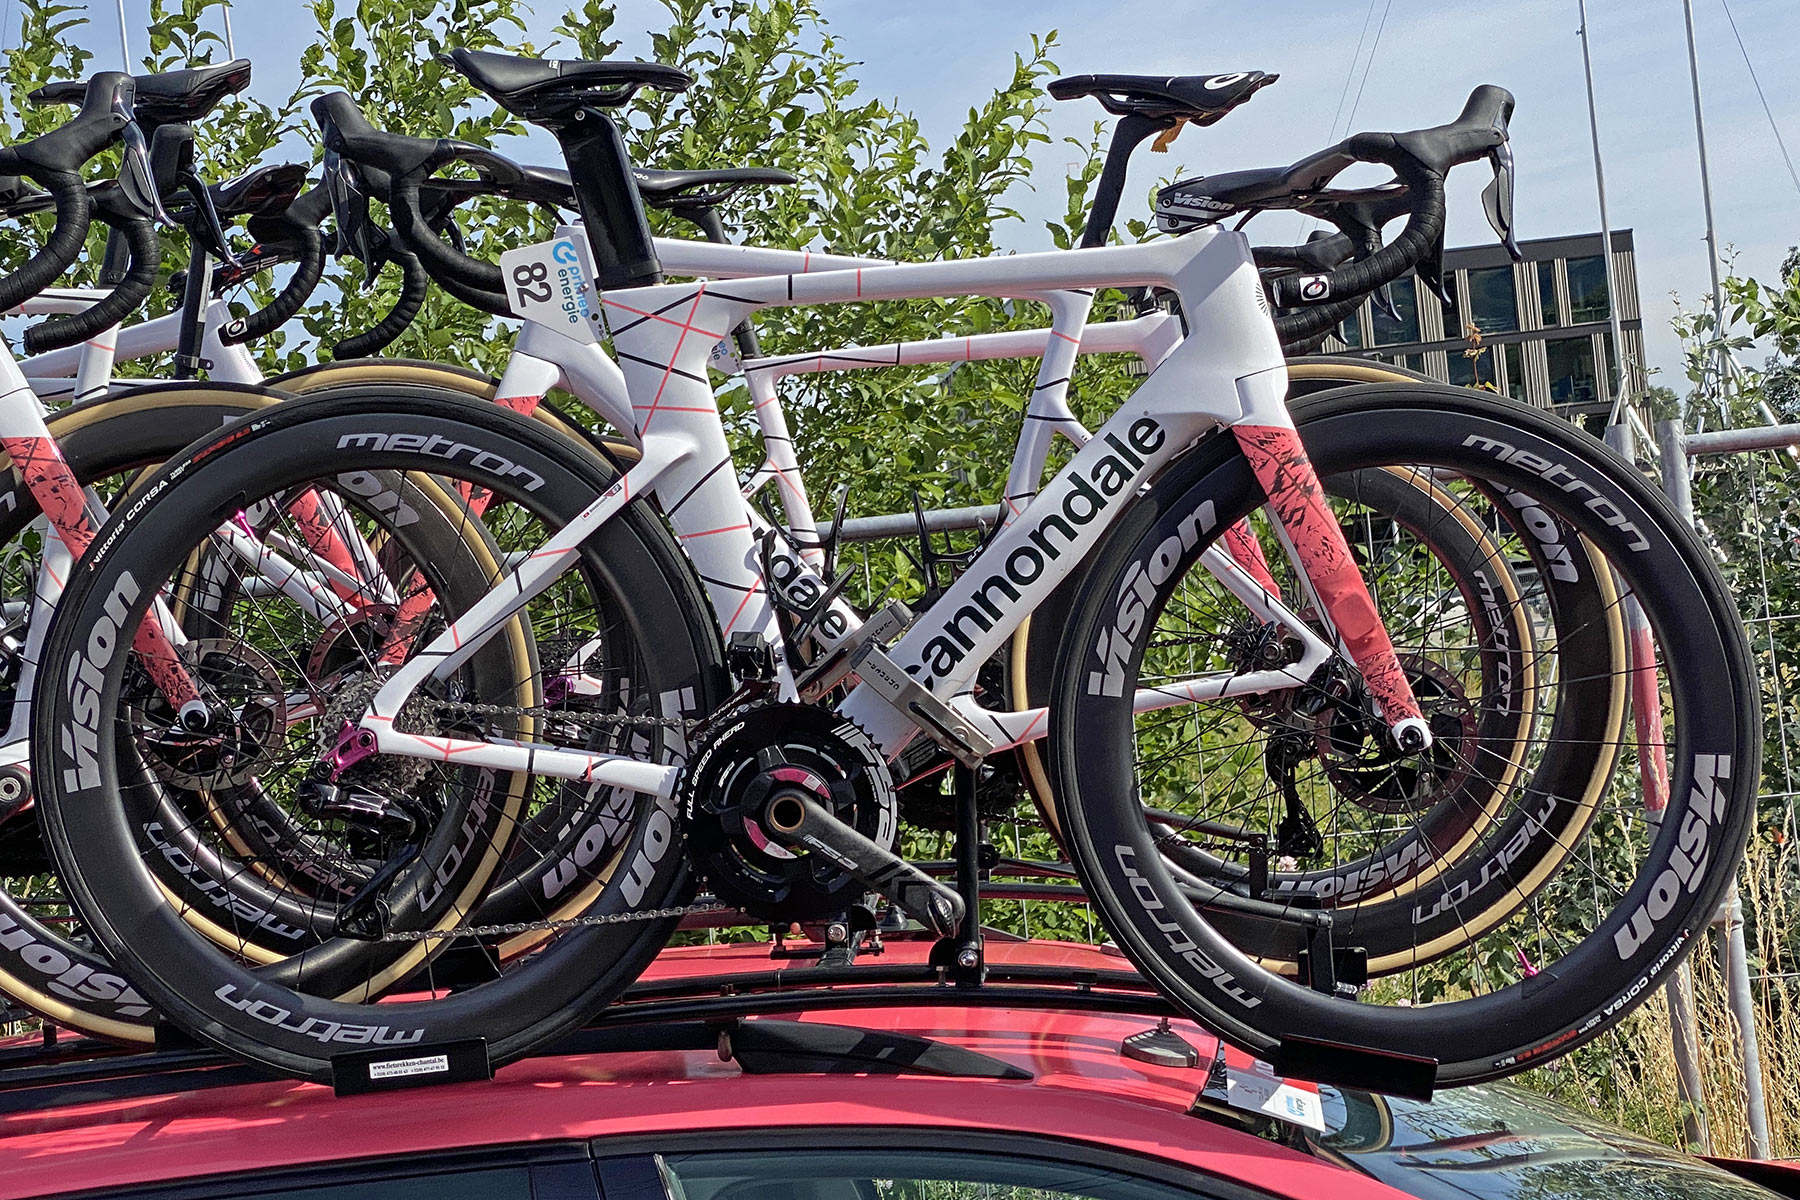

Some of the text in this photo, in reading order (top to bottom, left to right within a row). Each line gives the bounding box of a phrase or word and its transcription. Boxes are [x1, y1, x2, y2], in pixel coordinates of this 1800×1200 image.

[513, 262, 552, 308] 82
[558, 269, 579, 324] energie
[126, 479, 169, 522] CORSA
[336, 432, 546, 493] metron
[1461, 434, 1651, 552] metron
[1473, 569, 1512, 718] metron
[686, 721, 746, 820] FULL SPEED AHEAD
[142, 821, 306, 940] metron
[1411, 794, 1558, 925] metron
[1114, 844, 1263, 1009] metron
[214, 983, 425, 1045] metron
[1603, 977, 1649, 1016] CORSA
